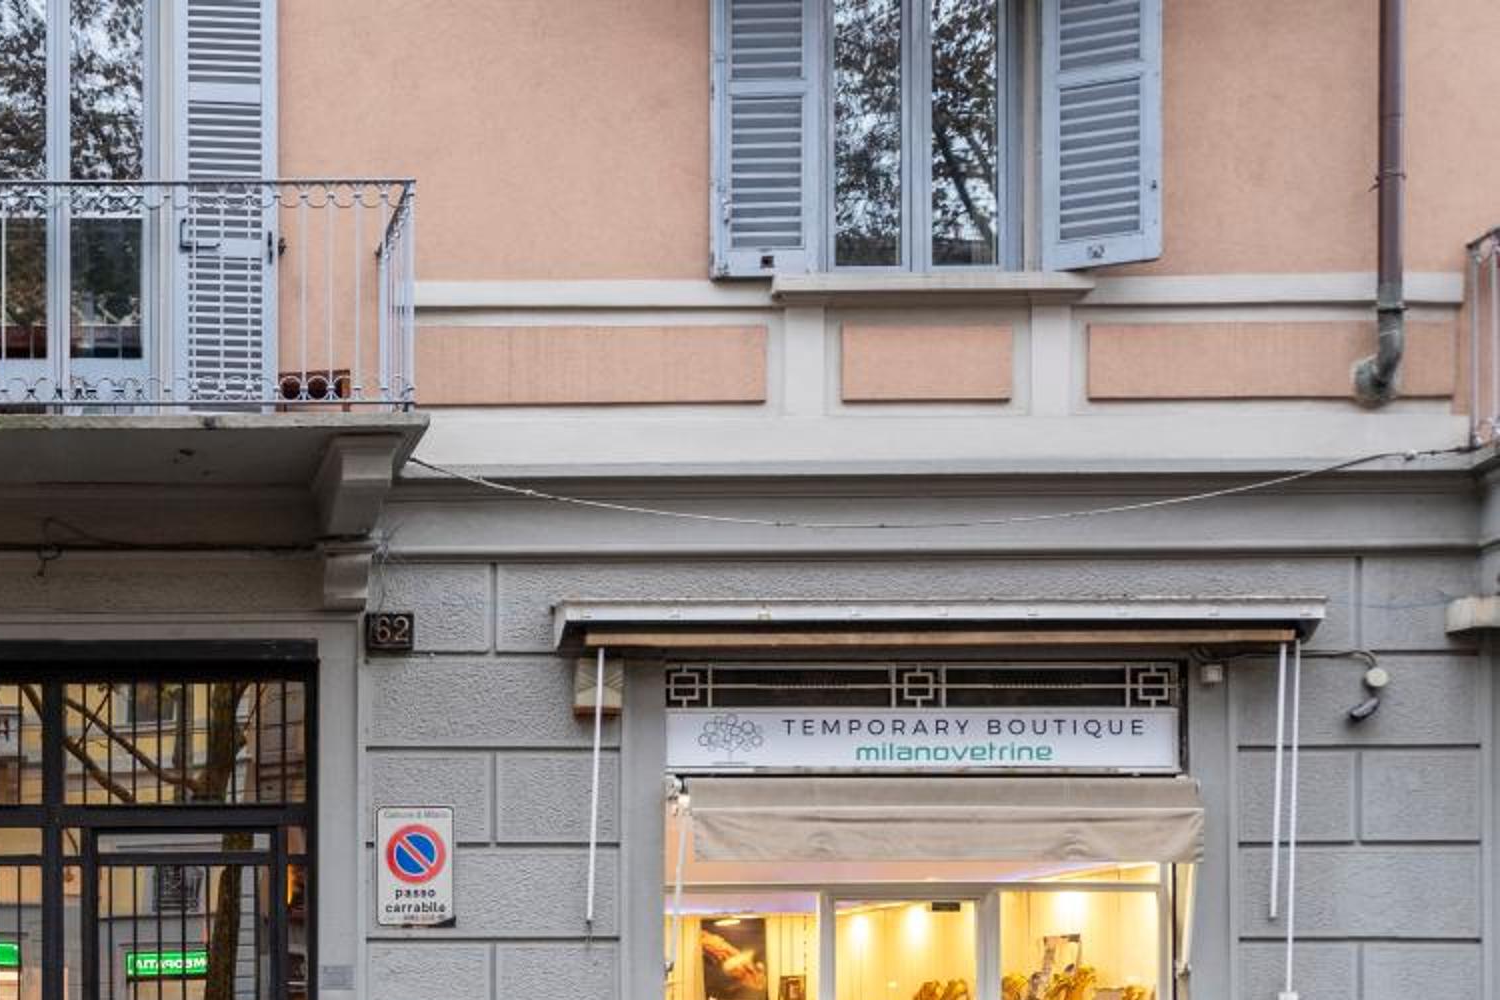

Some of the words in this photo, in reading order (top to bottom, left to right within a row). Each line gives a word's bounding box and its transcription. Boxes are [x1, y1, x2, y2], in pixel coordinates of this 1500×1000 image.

[377, 616, 409, 642] 62
[781, 719, 970, 736] TEMPORARY
[987, 719, 1145, 739] BOUTIQUE
[855, 742, 1054, 761] milanovetrine
[395, 889, 437, 900] passo
[385, 901, 446, 913] carrabile
